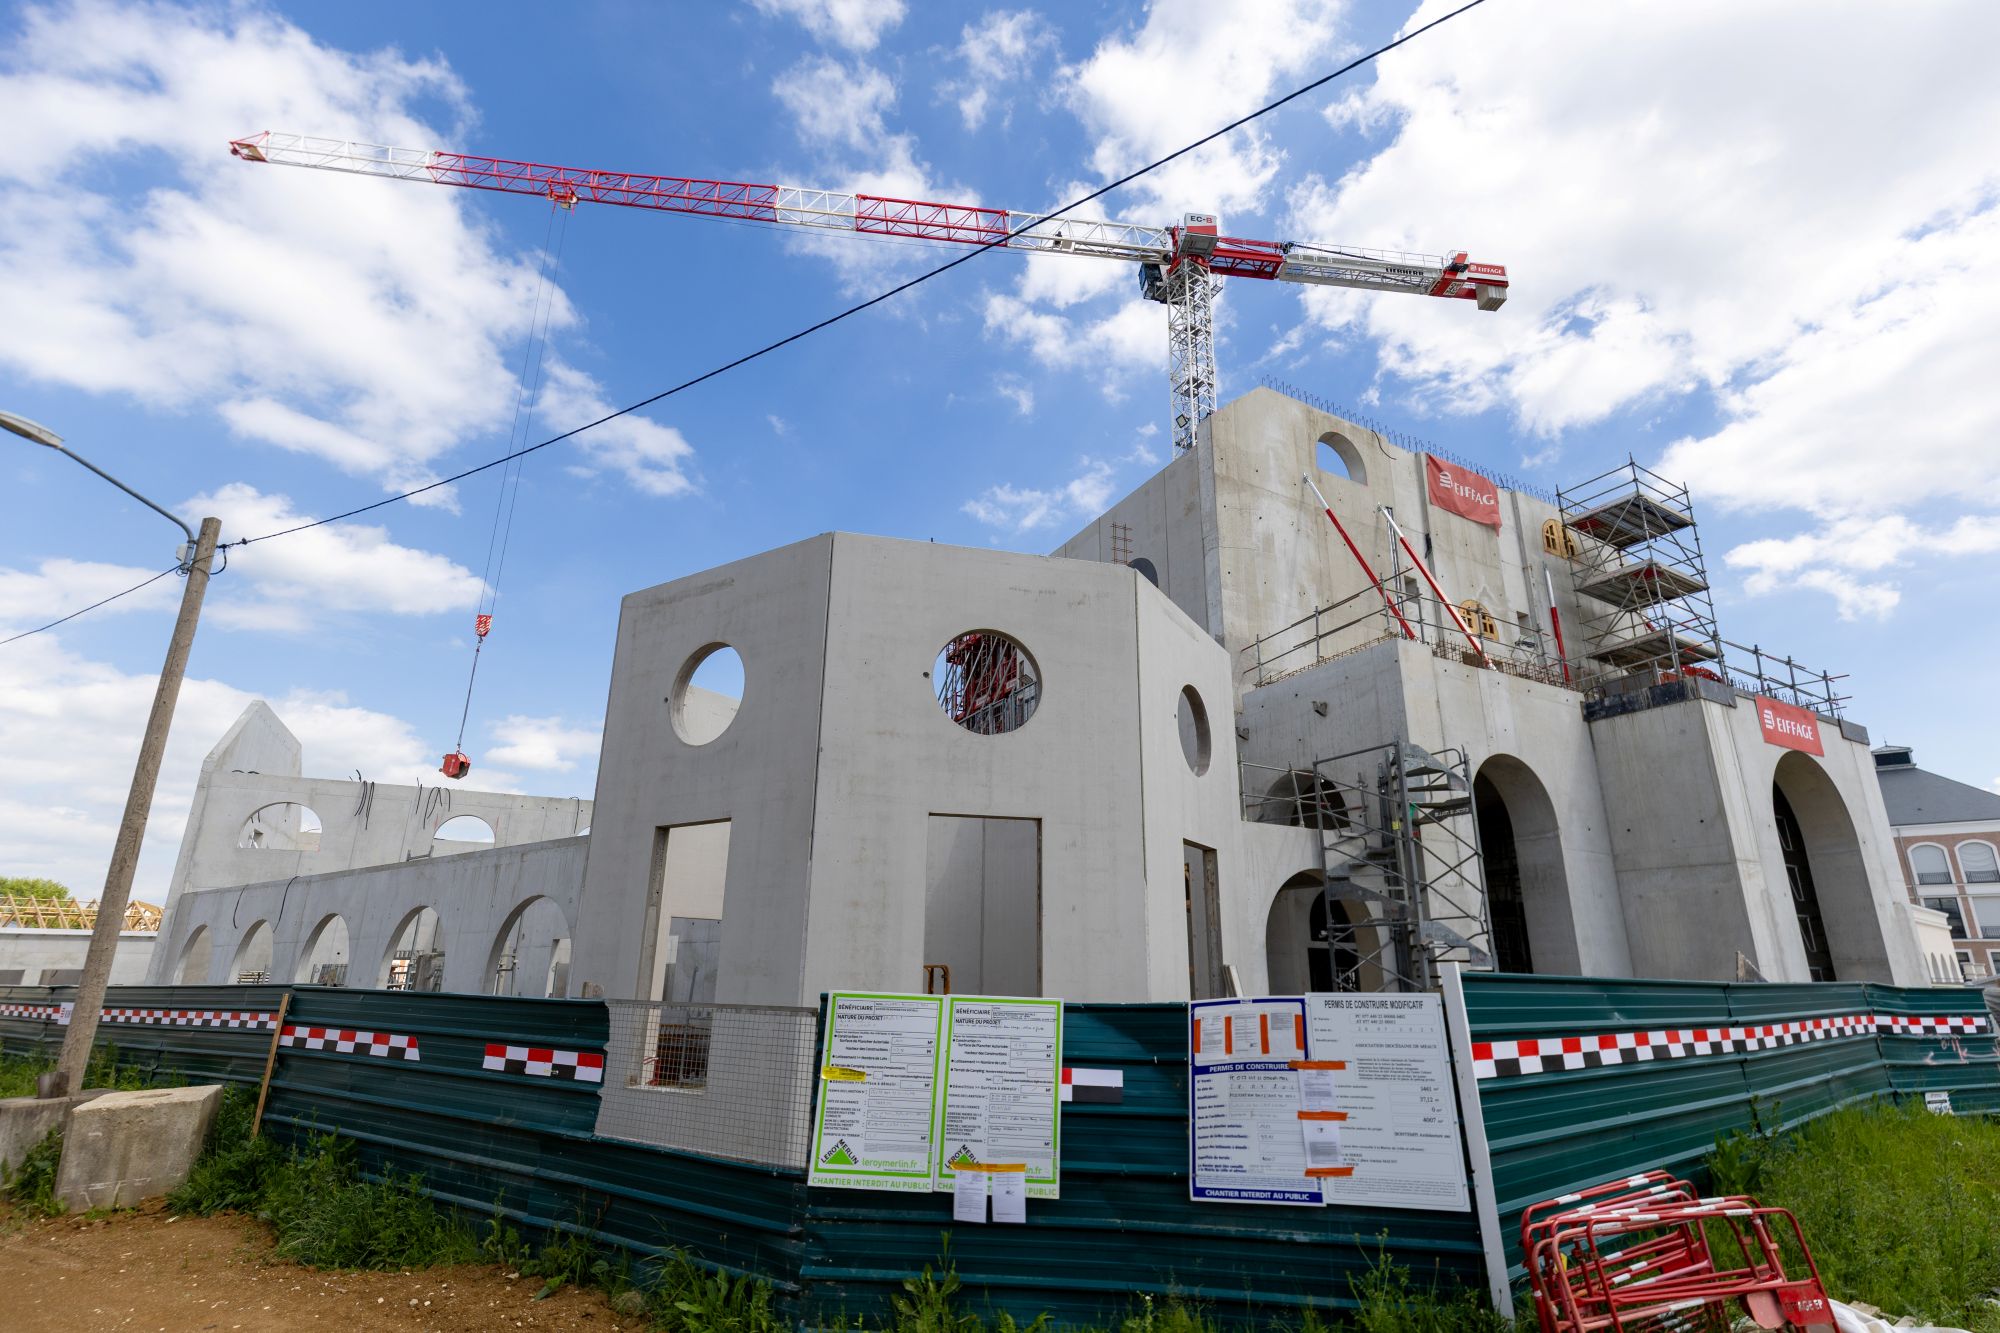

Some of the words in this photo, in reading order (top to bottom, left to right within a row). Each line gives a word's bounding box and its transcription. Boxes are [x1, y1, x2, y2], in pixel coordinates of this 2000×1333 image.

[1190, 216, 1212, 224] EC-B
[1454, 482, 1495, 505] EIFFAG
[1776, 717, 1814, 740] EIFFAGE
[1324, 1000, 1344, 1008] PERMIS
[1345, 1000, 1354, 1008] DE
[1354, 1000, 1388, 1009] CONSTRUIRE
[1390, 1001, 1423, 1009] MODIFICATIF
[1209, 1064, 1234, 1072] PERMIS
[820, 1143, 840, 1163] LEROY
[839, 1138, 859, 1164] MERLIN
[962, 1144, 984, 1169] MERLI
[862, 1158, 918, 1168] leroymerlin.fr
[944, 1150, 962, 1168] LEROY
[812, 1177, 851, 1186] CHANTIER
[853, 1179, 890, 1187] INTERDIT
[1028, 1188, 1056, 1196] PUBLIC
